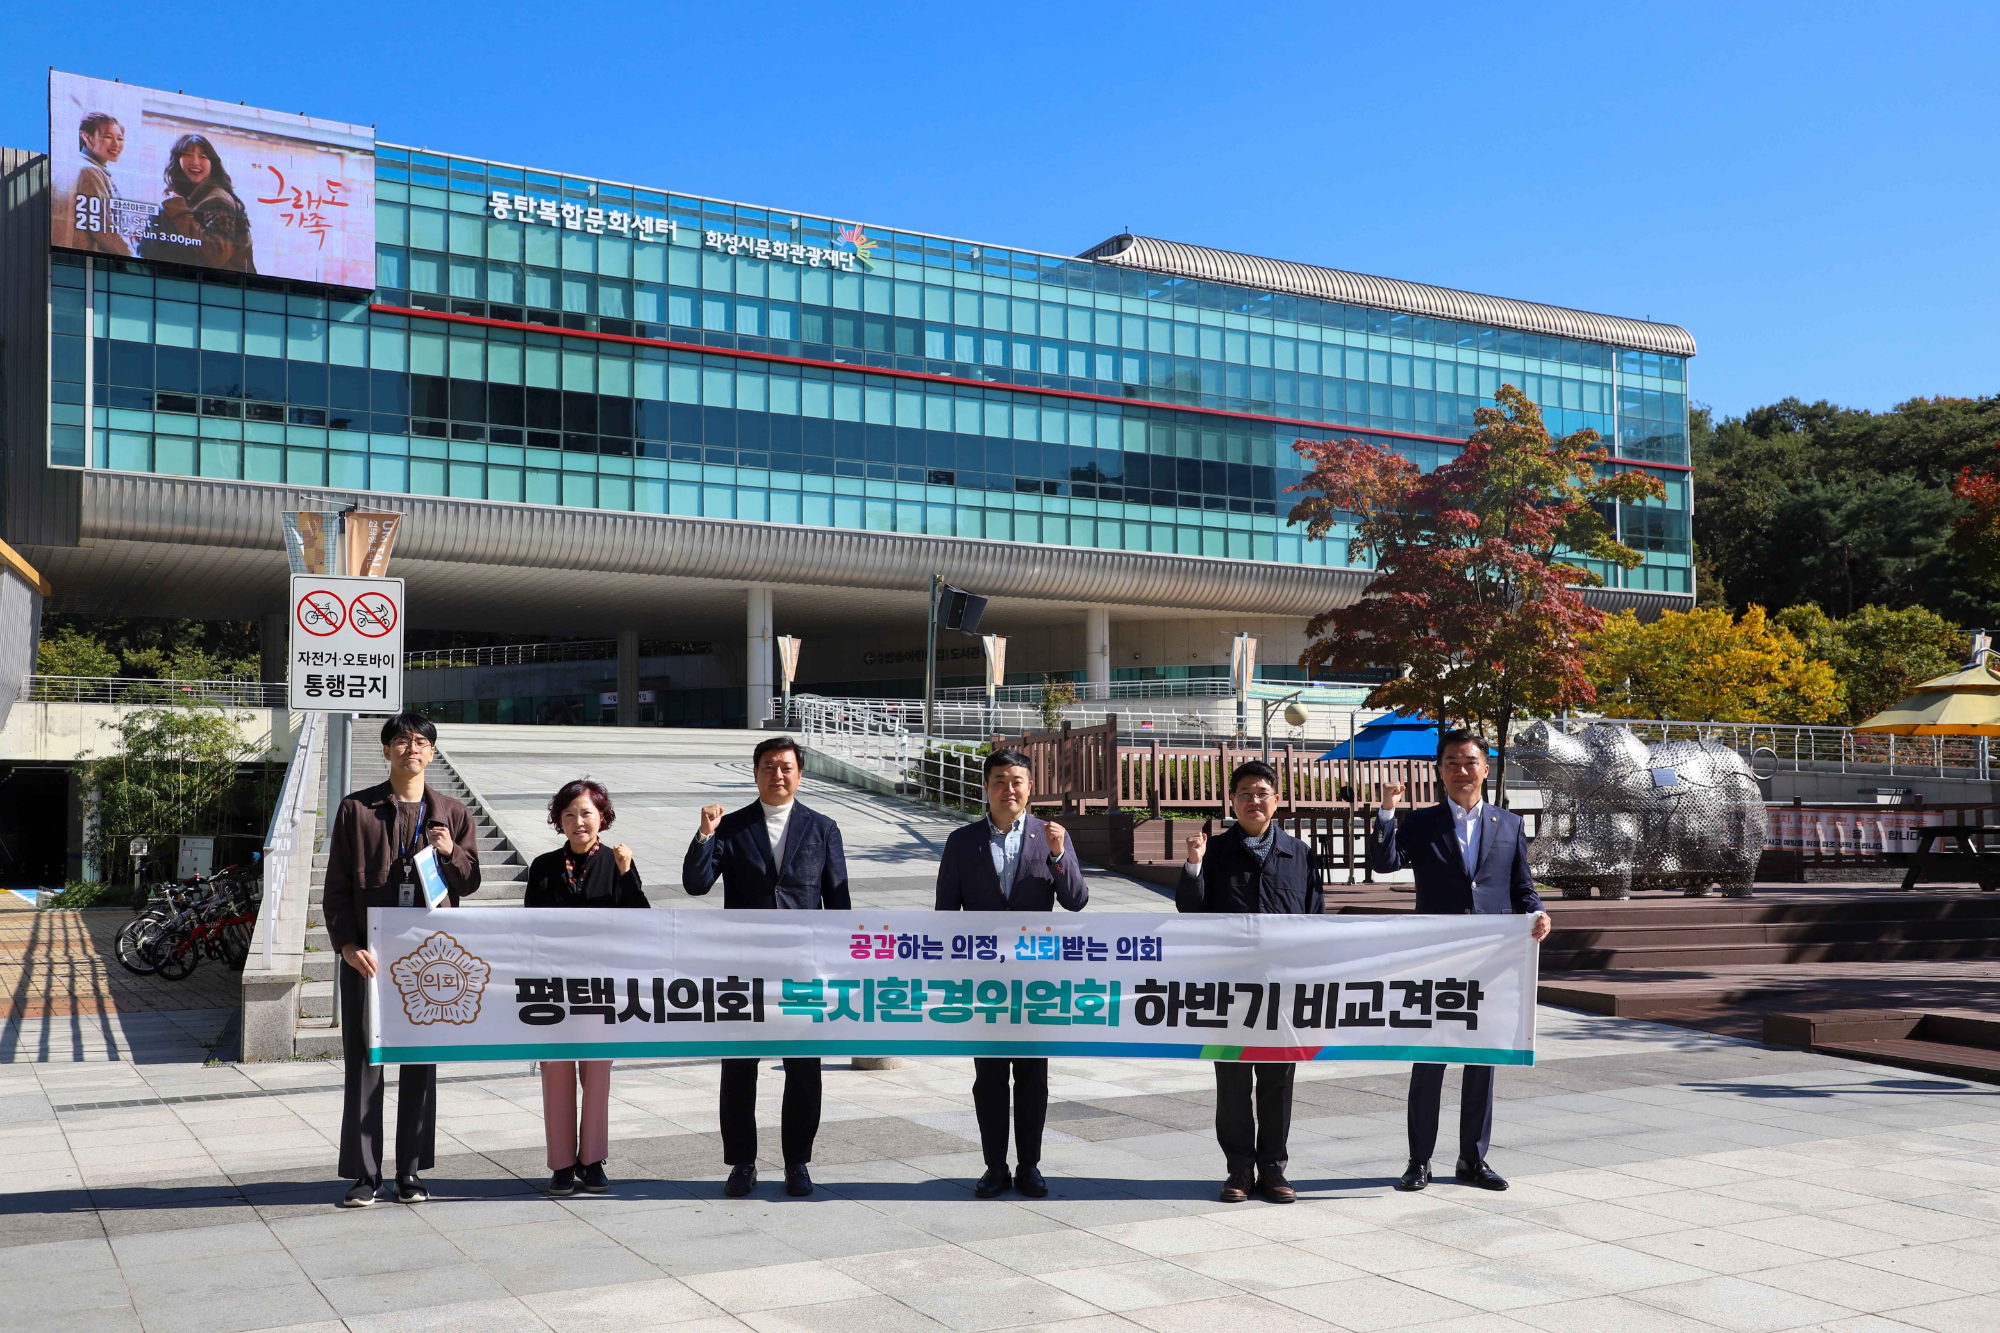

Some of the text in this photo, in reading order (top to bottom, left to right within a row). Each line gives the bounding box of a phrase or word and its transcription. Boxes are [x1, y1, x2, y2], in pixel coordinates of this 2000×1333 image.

[257, 165, 349, 210] 그래도
[75, 194, 101, 215] 20
[488, 190, 678, 243] 동탄복합문화센터
[75, 212, 101, 232] 25
[132, 217, 151, 228] Sat
[280, 212, 334, 251] 가족
[135, 229, 157, 240] Sun
[159, 232, 202, 247] 3:00pm
[705, 229, 855, 272] 화성시문화관광재단
[297, 651, 395, 668] 자전거·오토바이
[303, 674, 388, 699] 통행금지
[849, 933, 1163, 963] 공감하는 의정, 신뢰받는 의회
[423, 973, 460, 991] 의회
[514, 976, 1485, 1031] 평택시의회 복지환경위원회 하반기 비교견학
